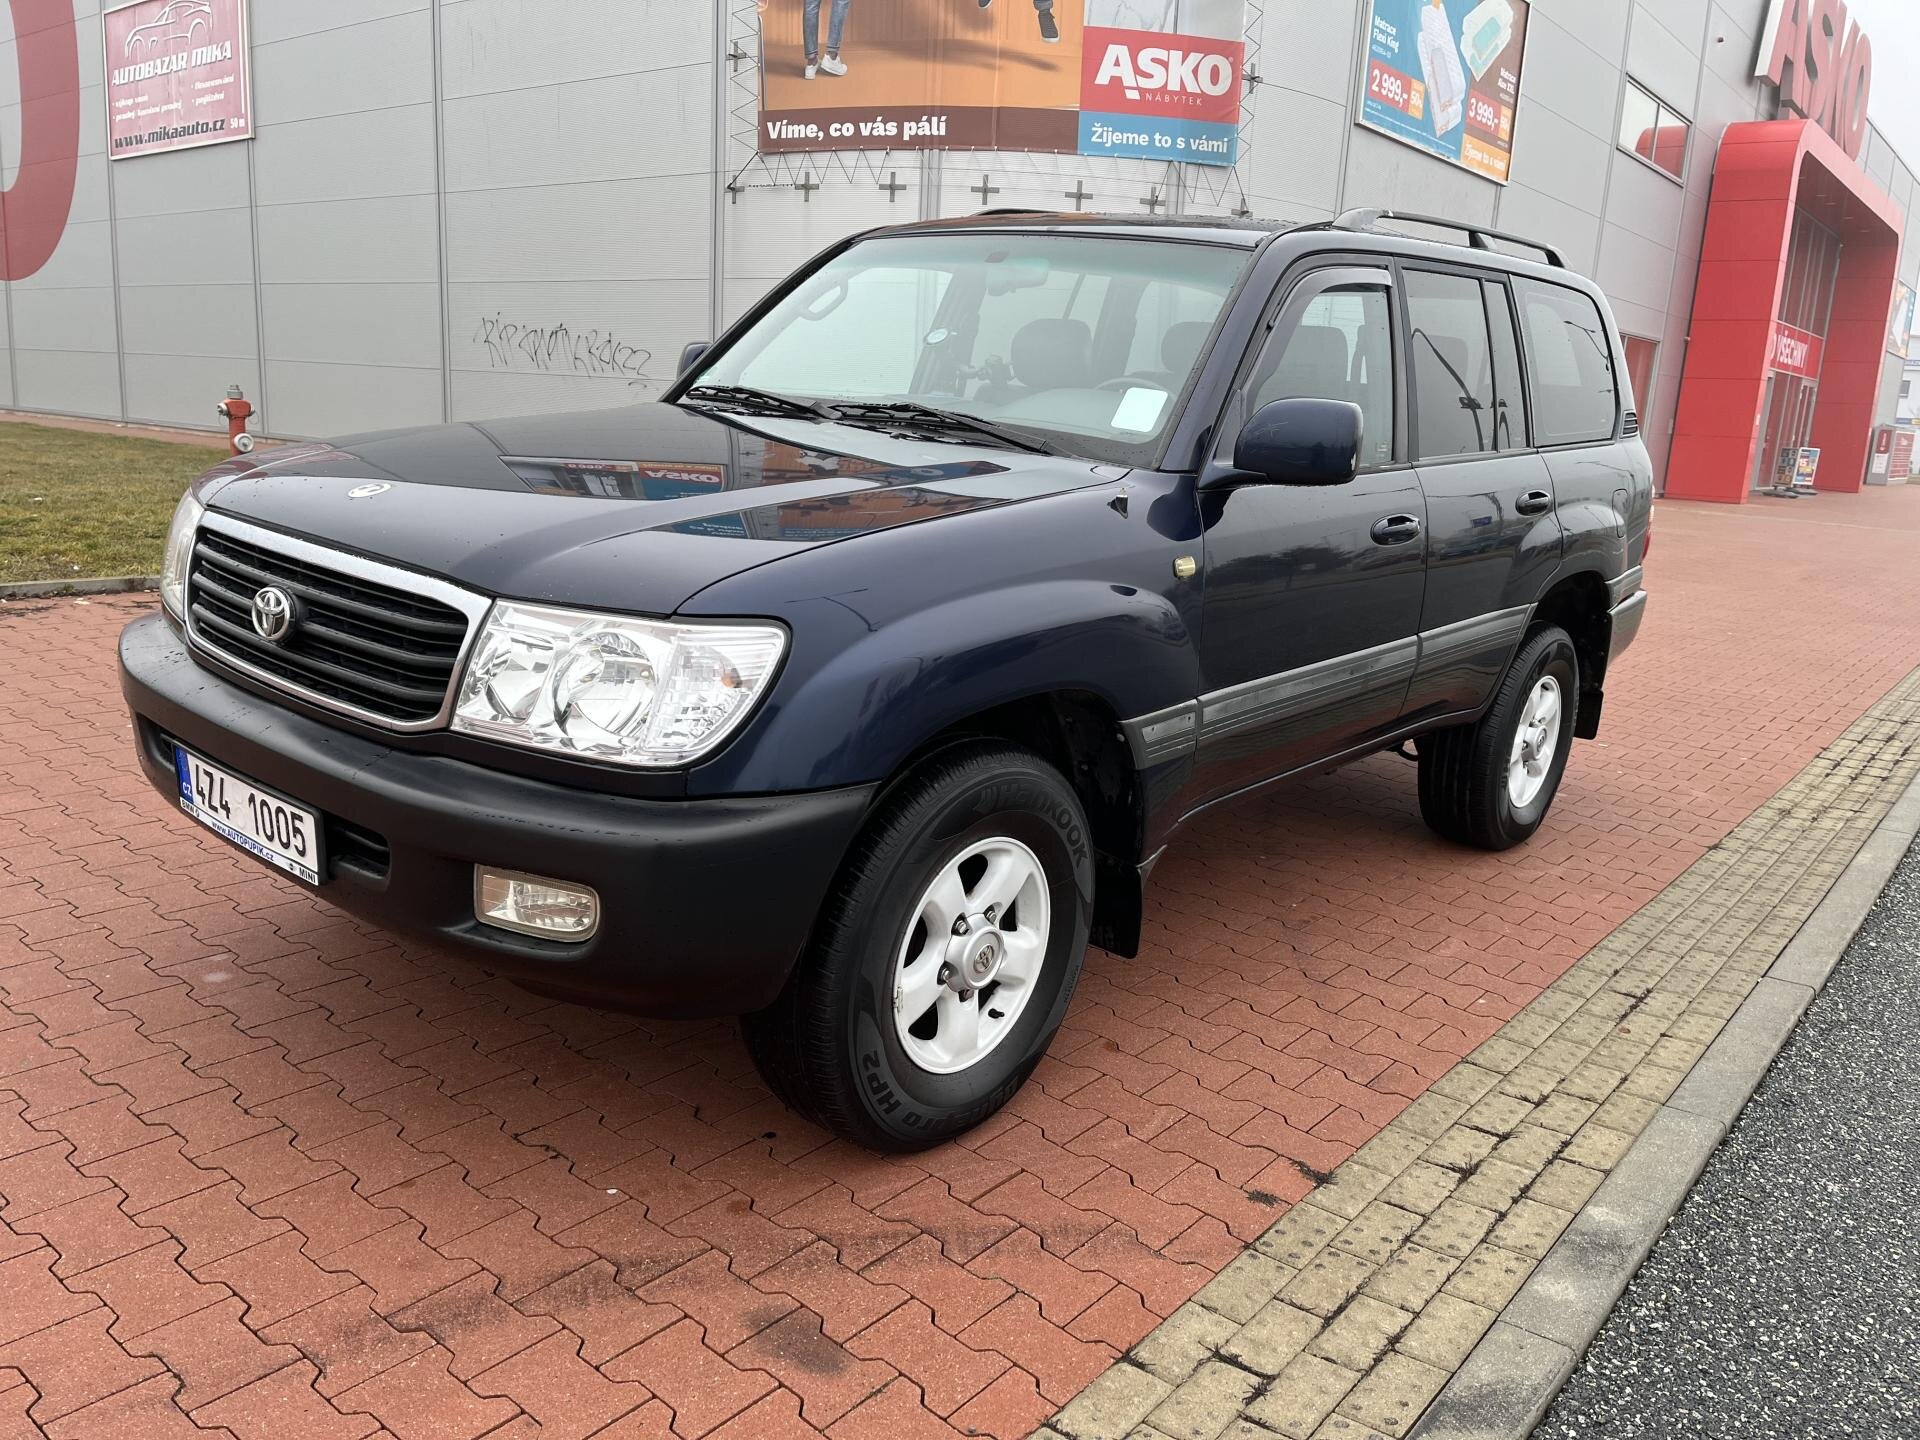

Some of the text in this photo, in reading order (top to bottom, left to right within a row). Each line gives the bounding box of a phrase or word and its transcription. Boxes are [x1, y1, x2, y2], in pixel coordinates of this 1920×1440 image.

[112, 40, 232, 87] AUTOBAZAR MIKA
[1094, 43, 1233, 100] ASKO
[1371, 69, 1380, 92] 2
[1145, 91, 1202, 106] NÁBYTEK
[1469, 98, 1476, 118] 3
[114, 118, 226, 149] www.mikaauto.cz
[767, 115, 947, 141] Víme, co vás pálí
[1091, 123, 1228, 153] Žijeme to s vámi
[182, 781, 193, 797] CZ
[195, 763, 306, 858] 4Z4 1005
[211, 820, 274, 862] www.AUTOPUPIK.cz
[298, 866, 316, 884] MINI
[862, 1049, 903, 1116] HP2
